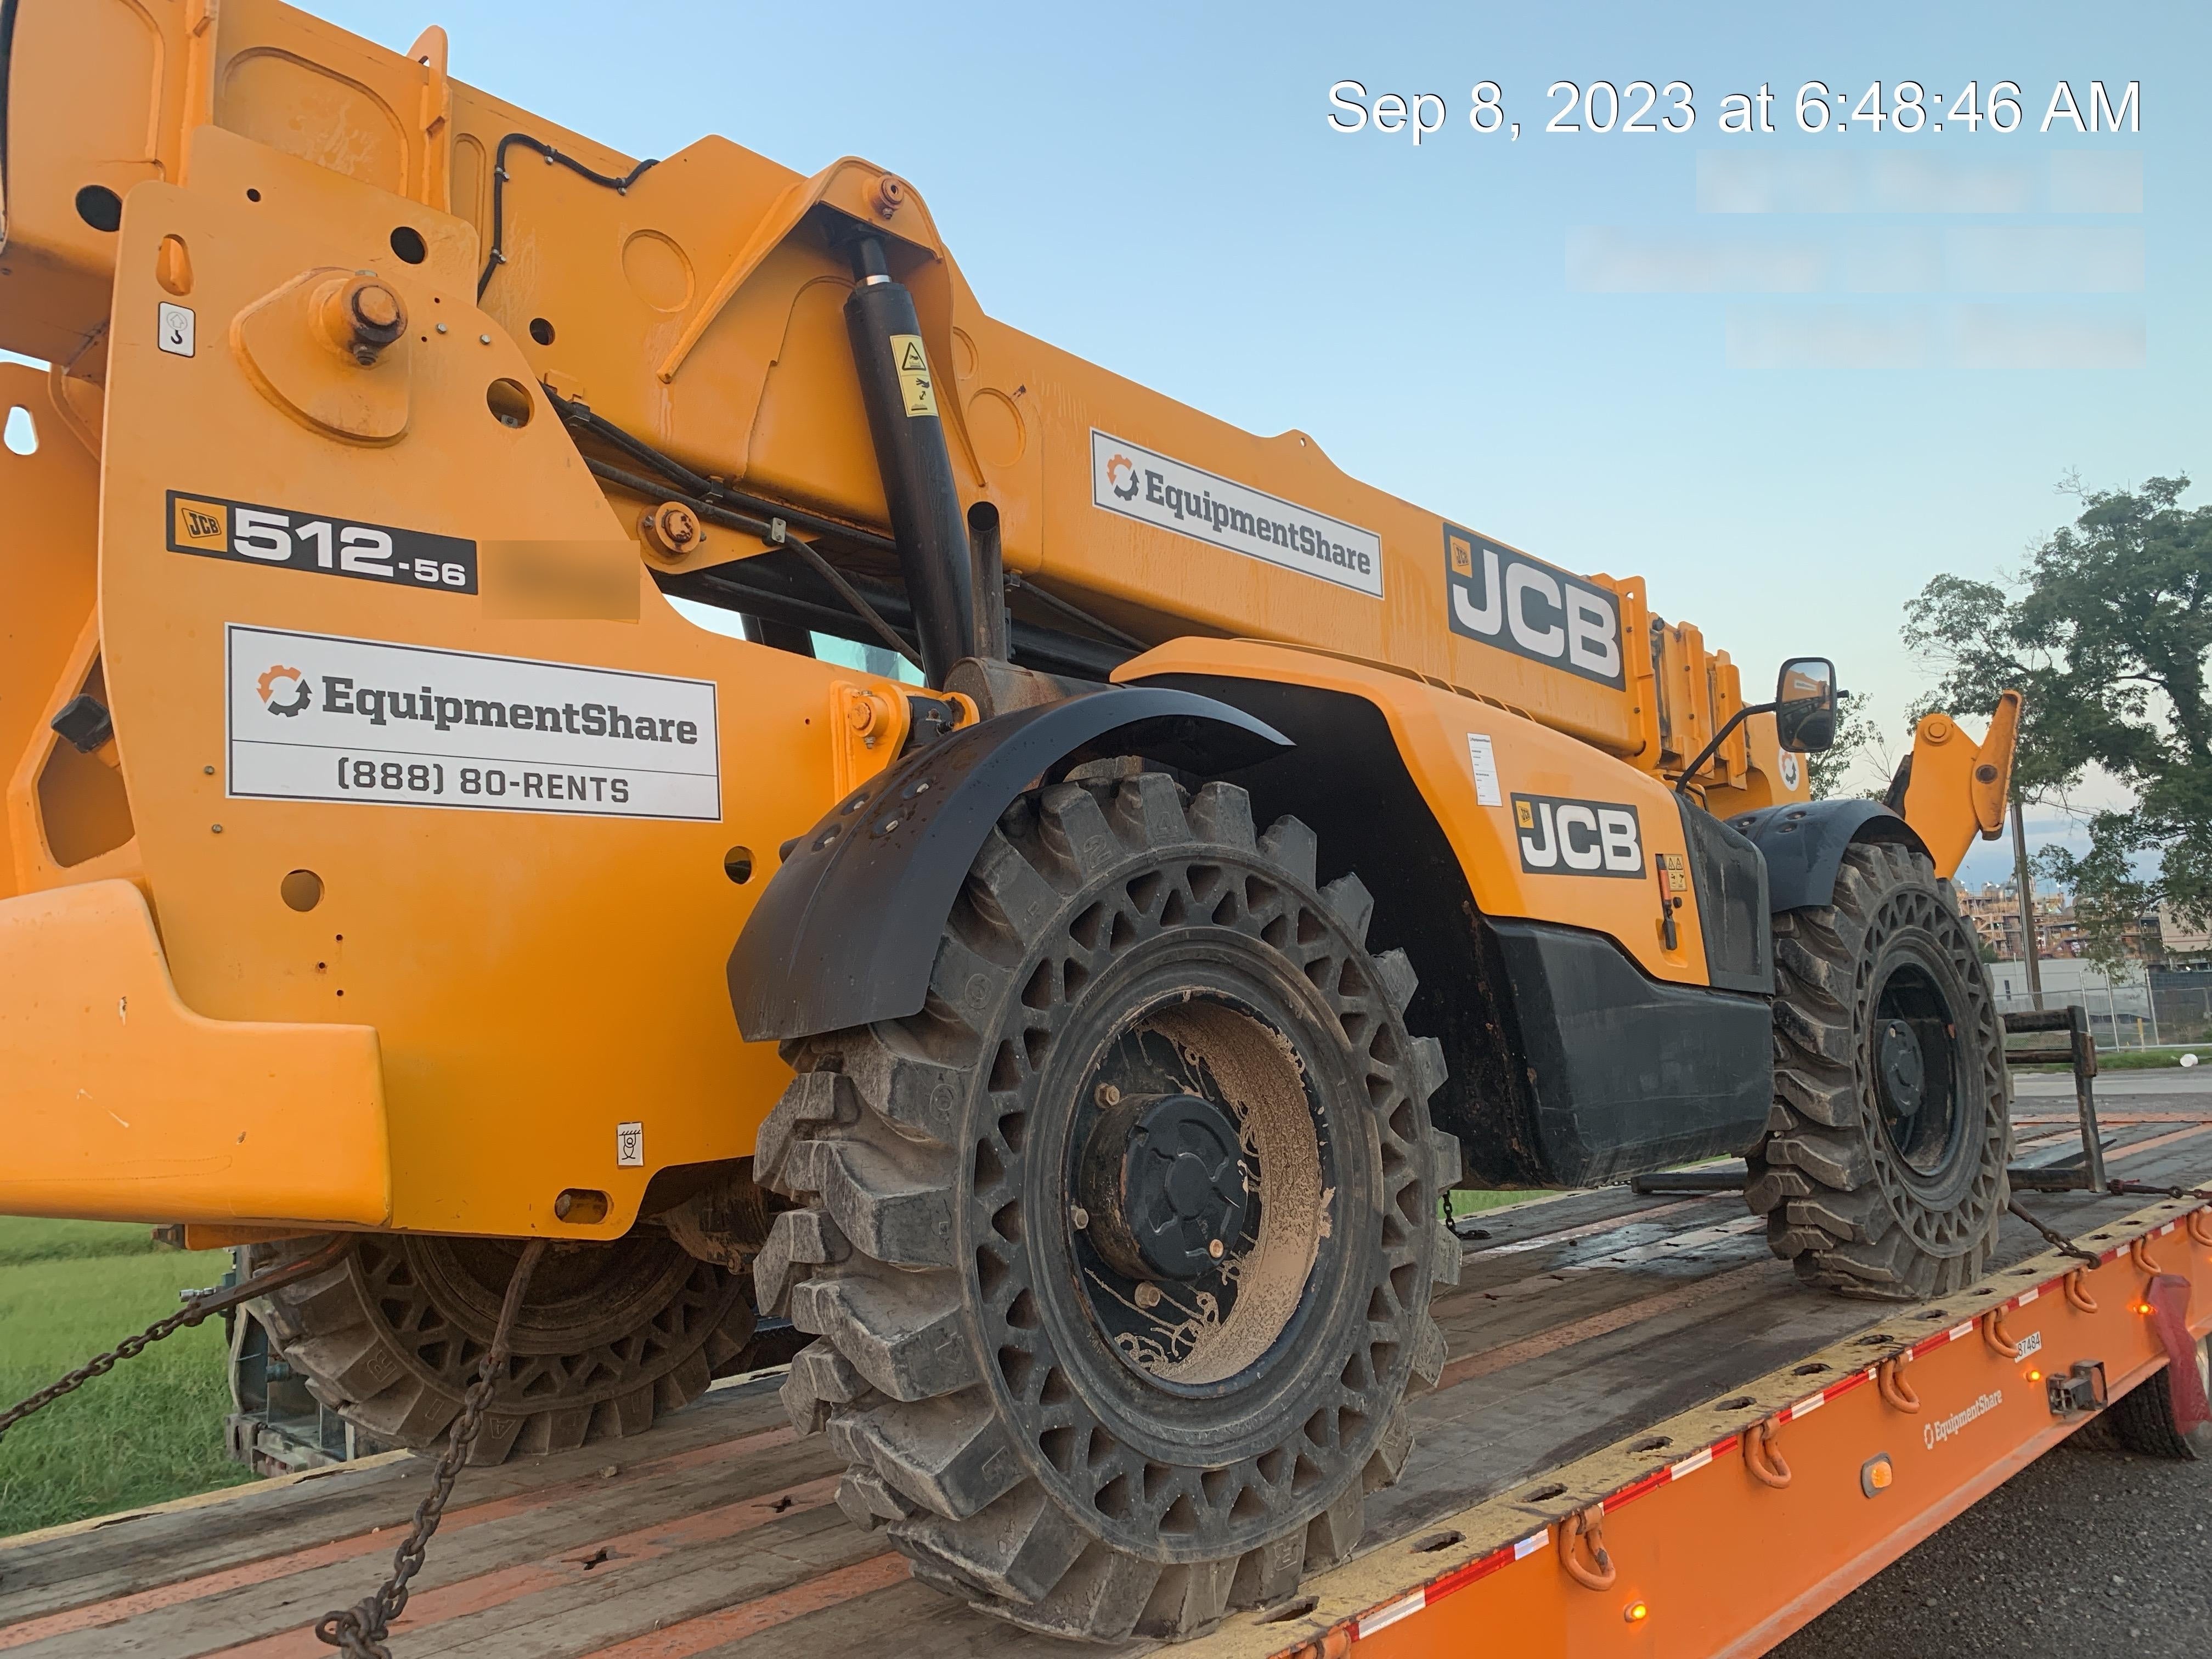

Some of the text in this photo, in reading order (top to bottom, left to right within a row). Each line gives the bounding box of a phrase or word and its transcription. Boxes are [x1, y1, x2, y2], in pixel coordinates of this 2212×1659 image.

[188, 511, 219, 535] JCB
[1145, 469, 1371, 575] EquipmentShare
[1452, 549, 1621, 679] JCB
[322, 675, 698, 745] EquipmentShare
[338, 757, 630, 804] (888) 80-RENTS
[1521, 803, 1641, 871] JCB
[1933, 1389, 2003, 1442] EquipmentShare
